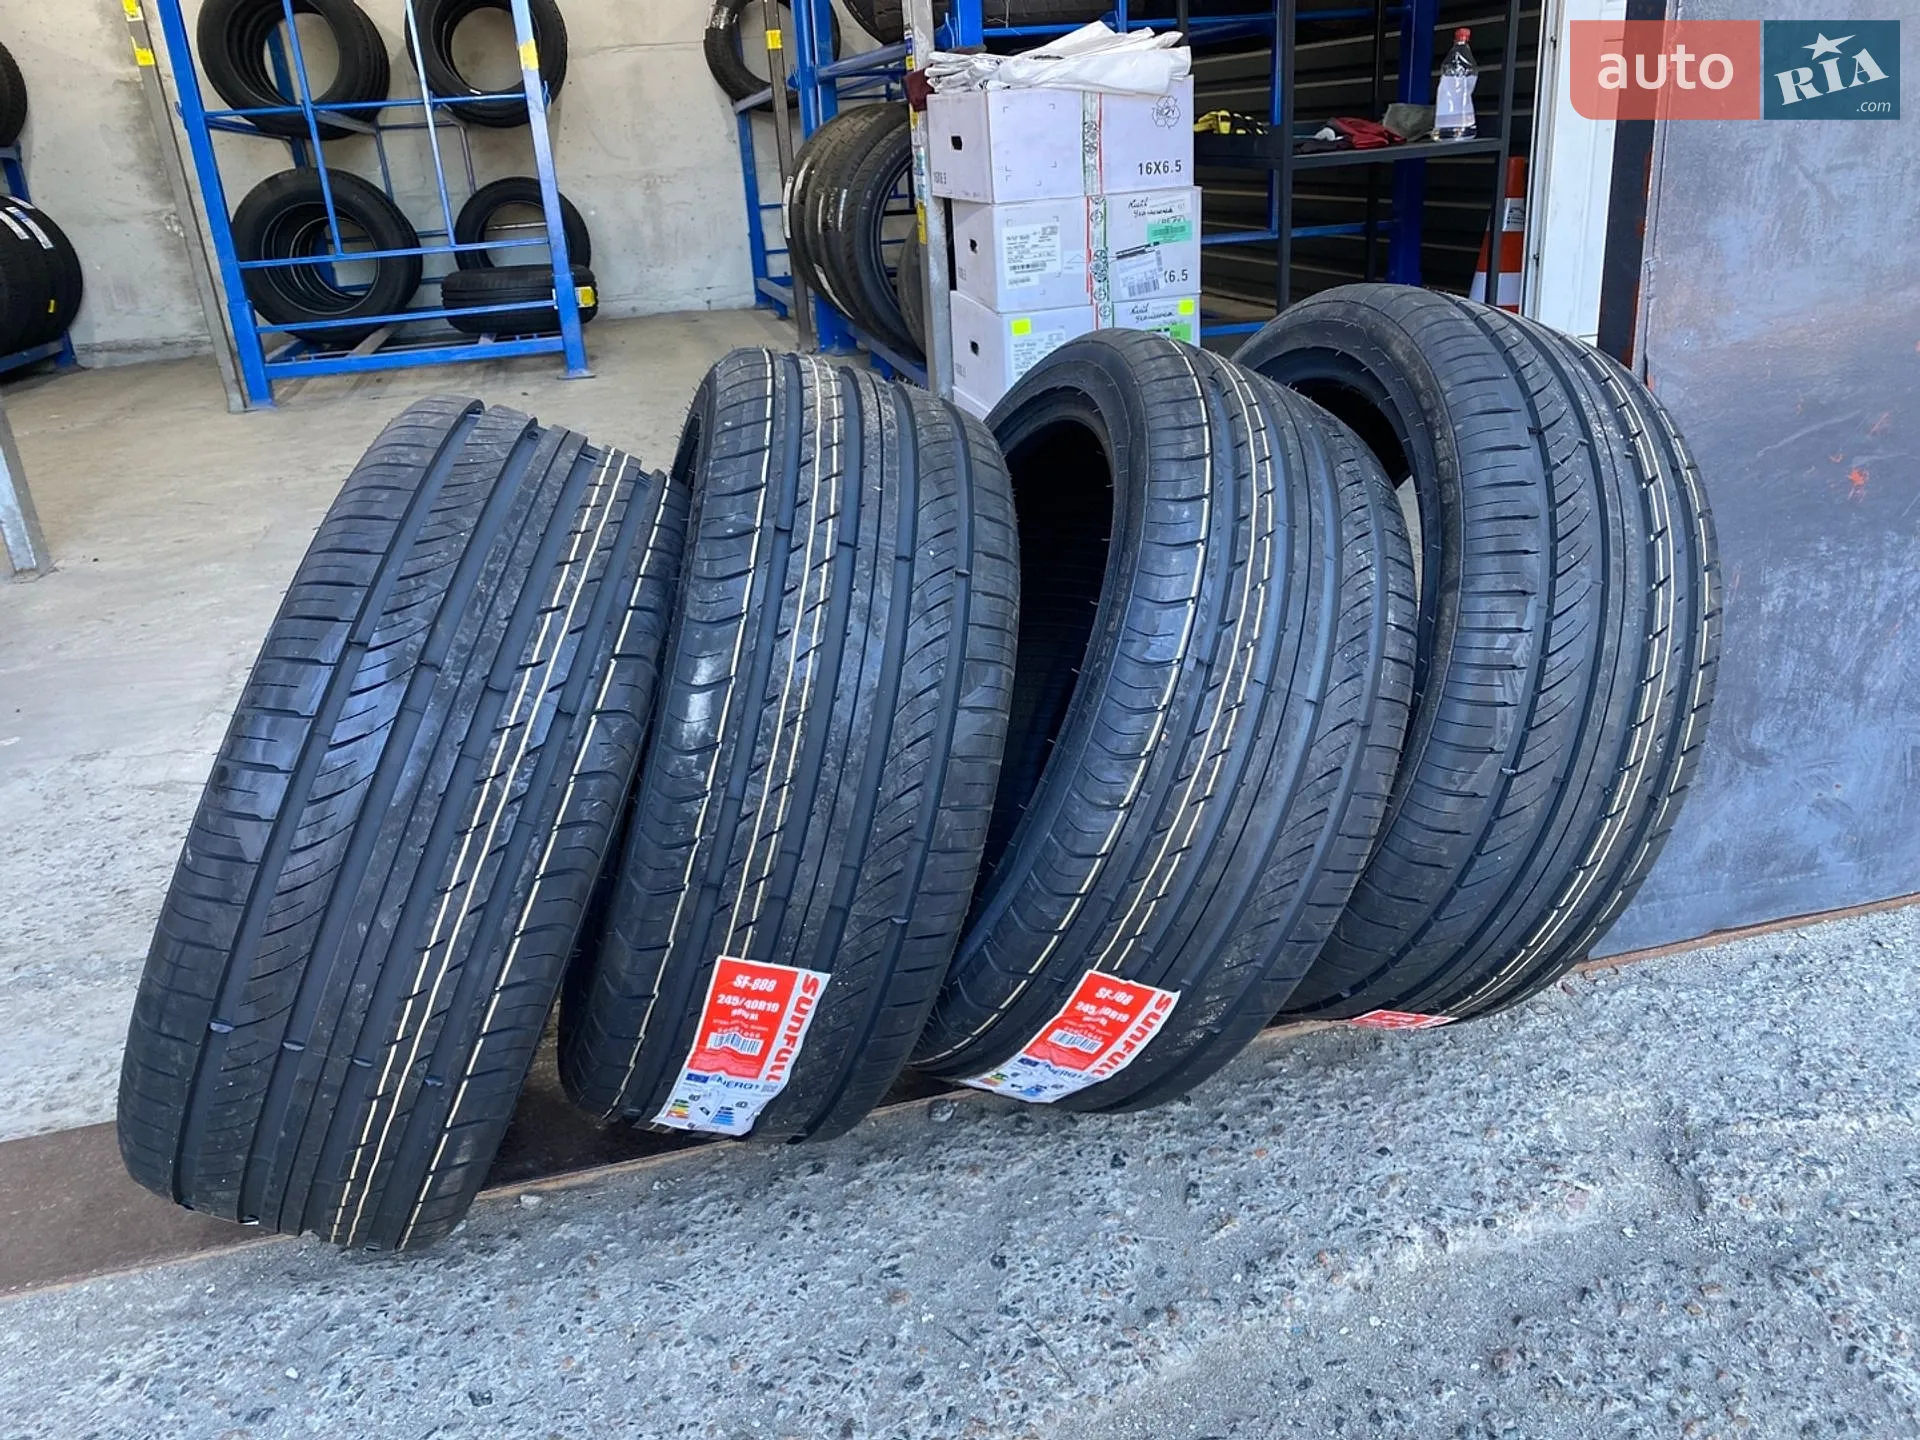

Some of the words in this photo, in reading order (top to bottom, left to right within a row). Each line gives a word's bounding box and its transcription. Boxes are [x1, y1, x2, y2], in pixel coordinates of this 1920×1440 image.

[1138, 159, 1182, 176] 16X6.5
[733, 974, 777, 992] SF-888
[716, 993, 780, 1013] 245/40R19
